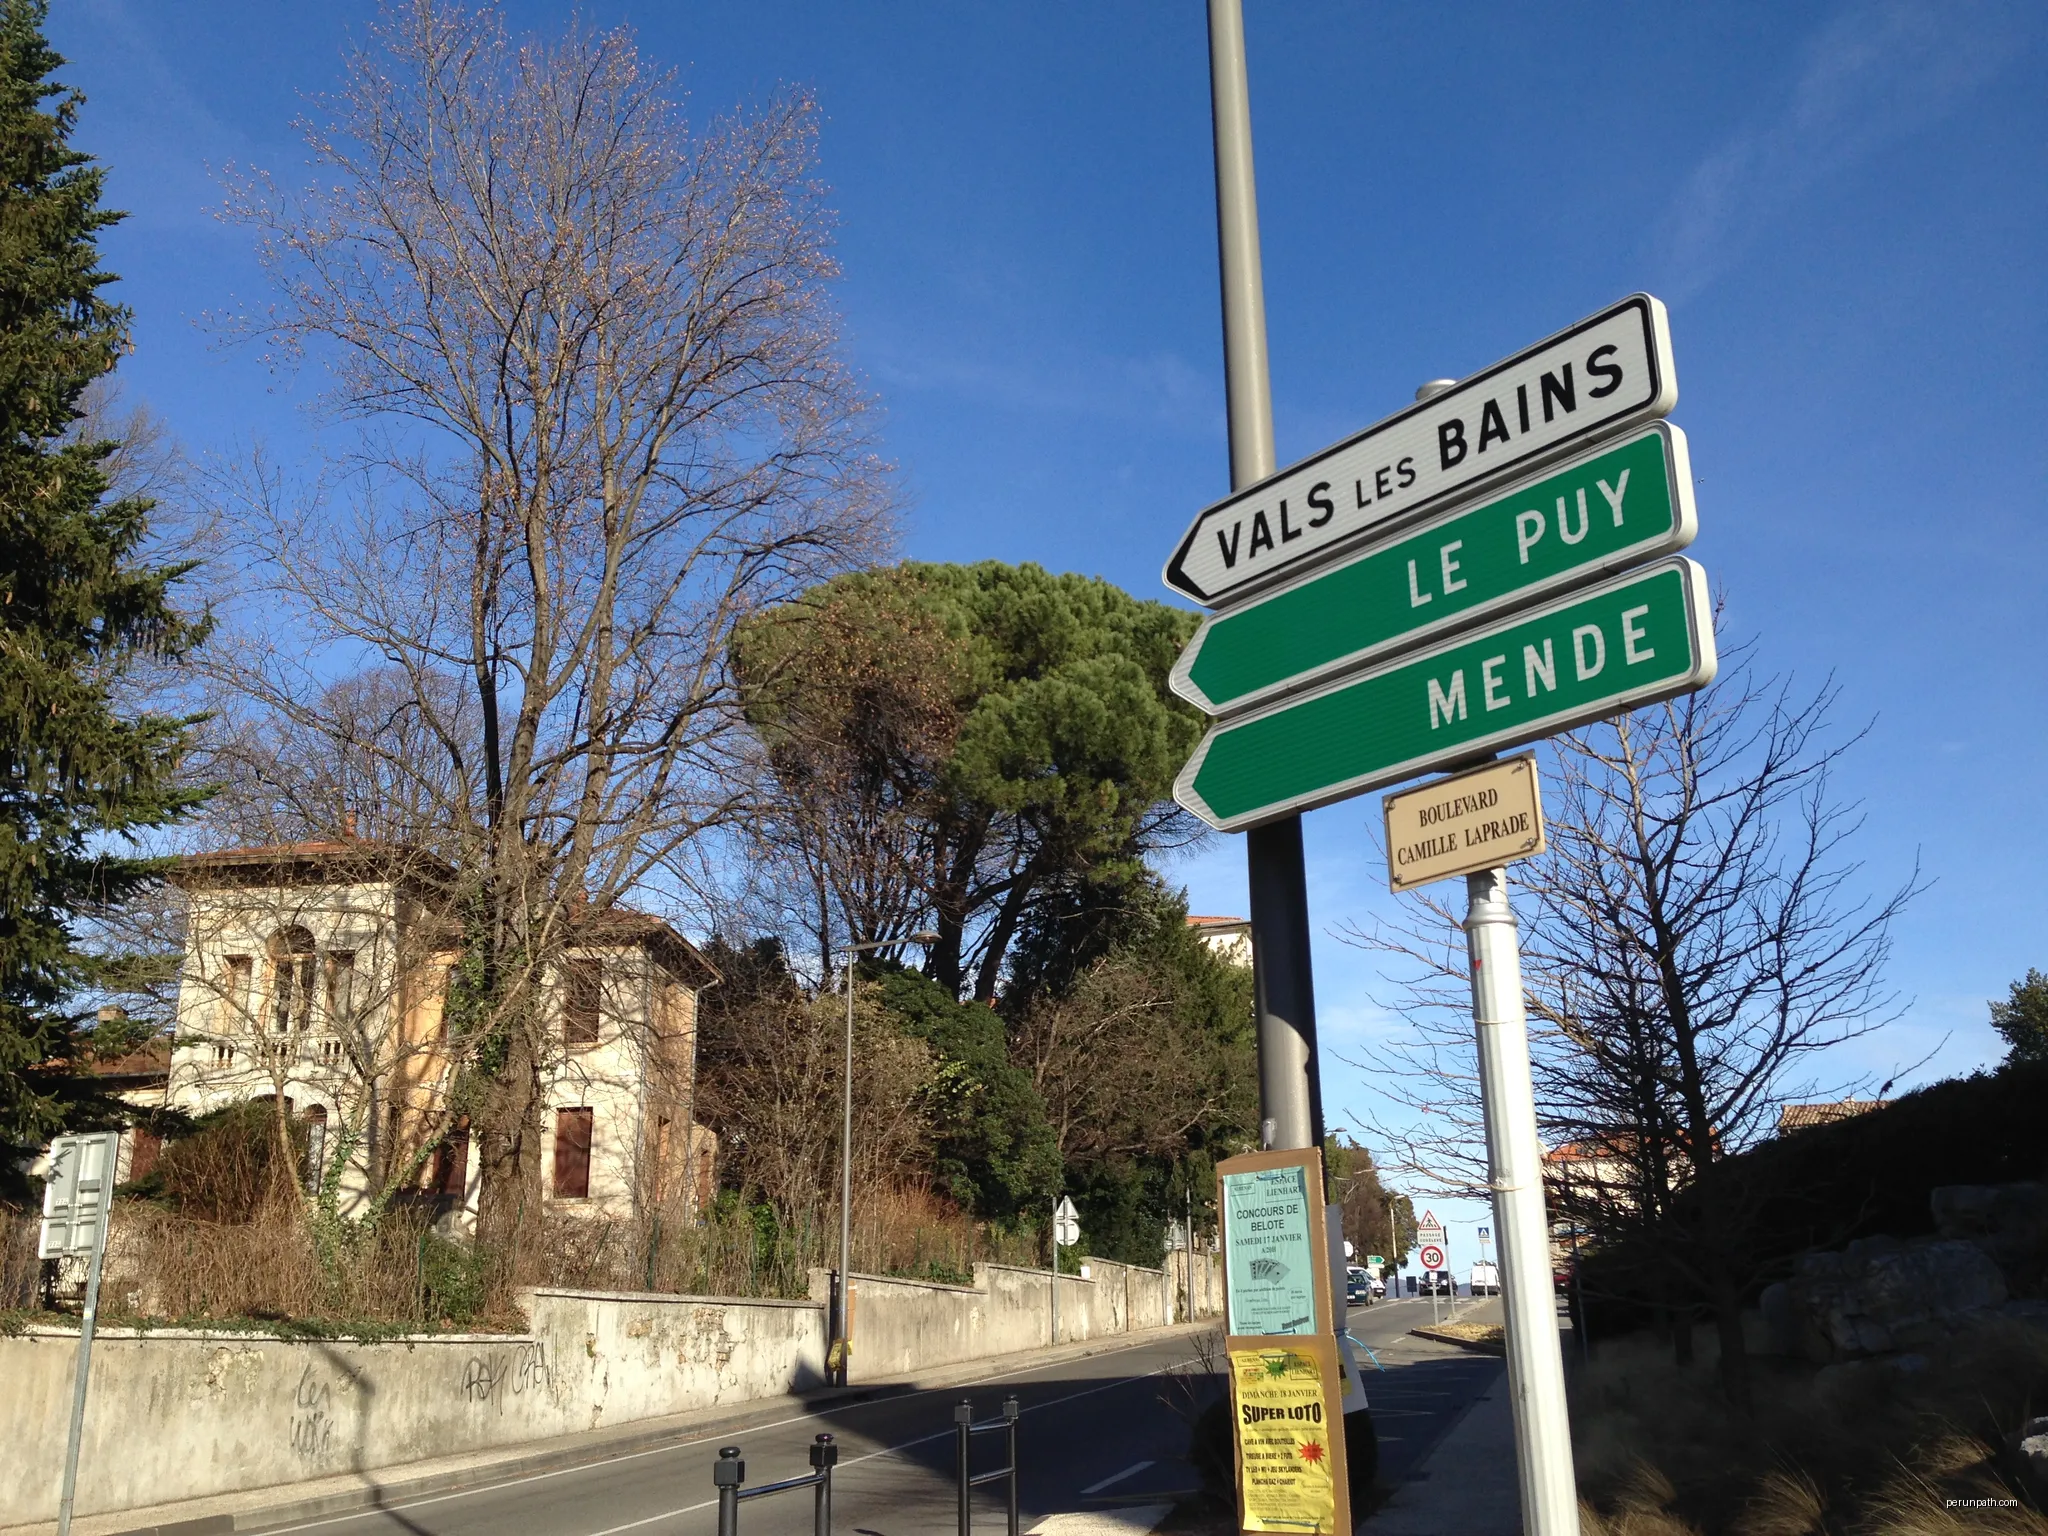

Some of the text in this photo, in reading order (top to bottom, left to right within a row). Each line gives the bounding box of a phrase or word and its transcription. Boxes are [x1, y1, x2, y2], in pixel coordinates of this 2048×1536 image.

[1216, 344, 1624, 569] VALS LES BAINS
[1407, 468, 1632, 608] LE PUY
[1427, 604, 1656, 731] MENDE
[1419, 788, 1499, 828] BOULEVARD
[1397, 812, 1530, 866] CAMILLE LAPRADE
[1236, 1204, 1299, 1220] CONCOURS DE
[1251, 1219, 1285, 1232] BELOTE
[1235, 1236, 1262, 1247] SAMEDI
[1271, 1232, 1302, 1244] JANVIER
[1425, 1252, 1439, 1263] 30
[1242, 1389, 1278, 1399] DIMANCHE
[1287, 1389, 1318, 1398] JANVIER
[1241, 1401, 1322, 1425] SUPER LOTO
